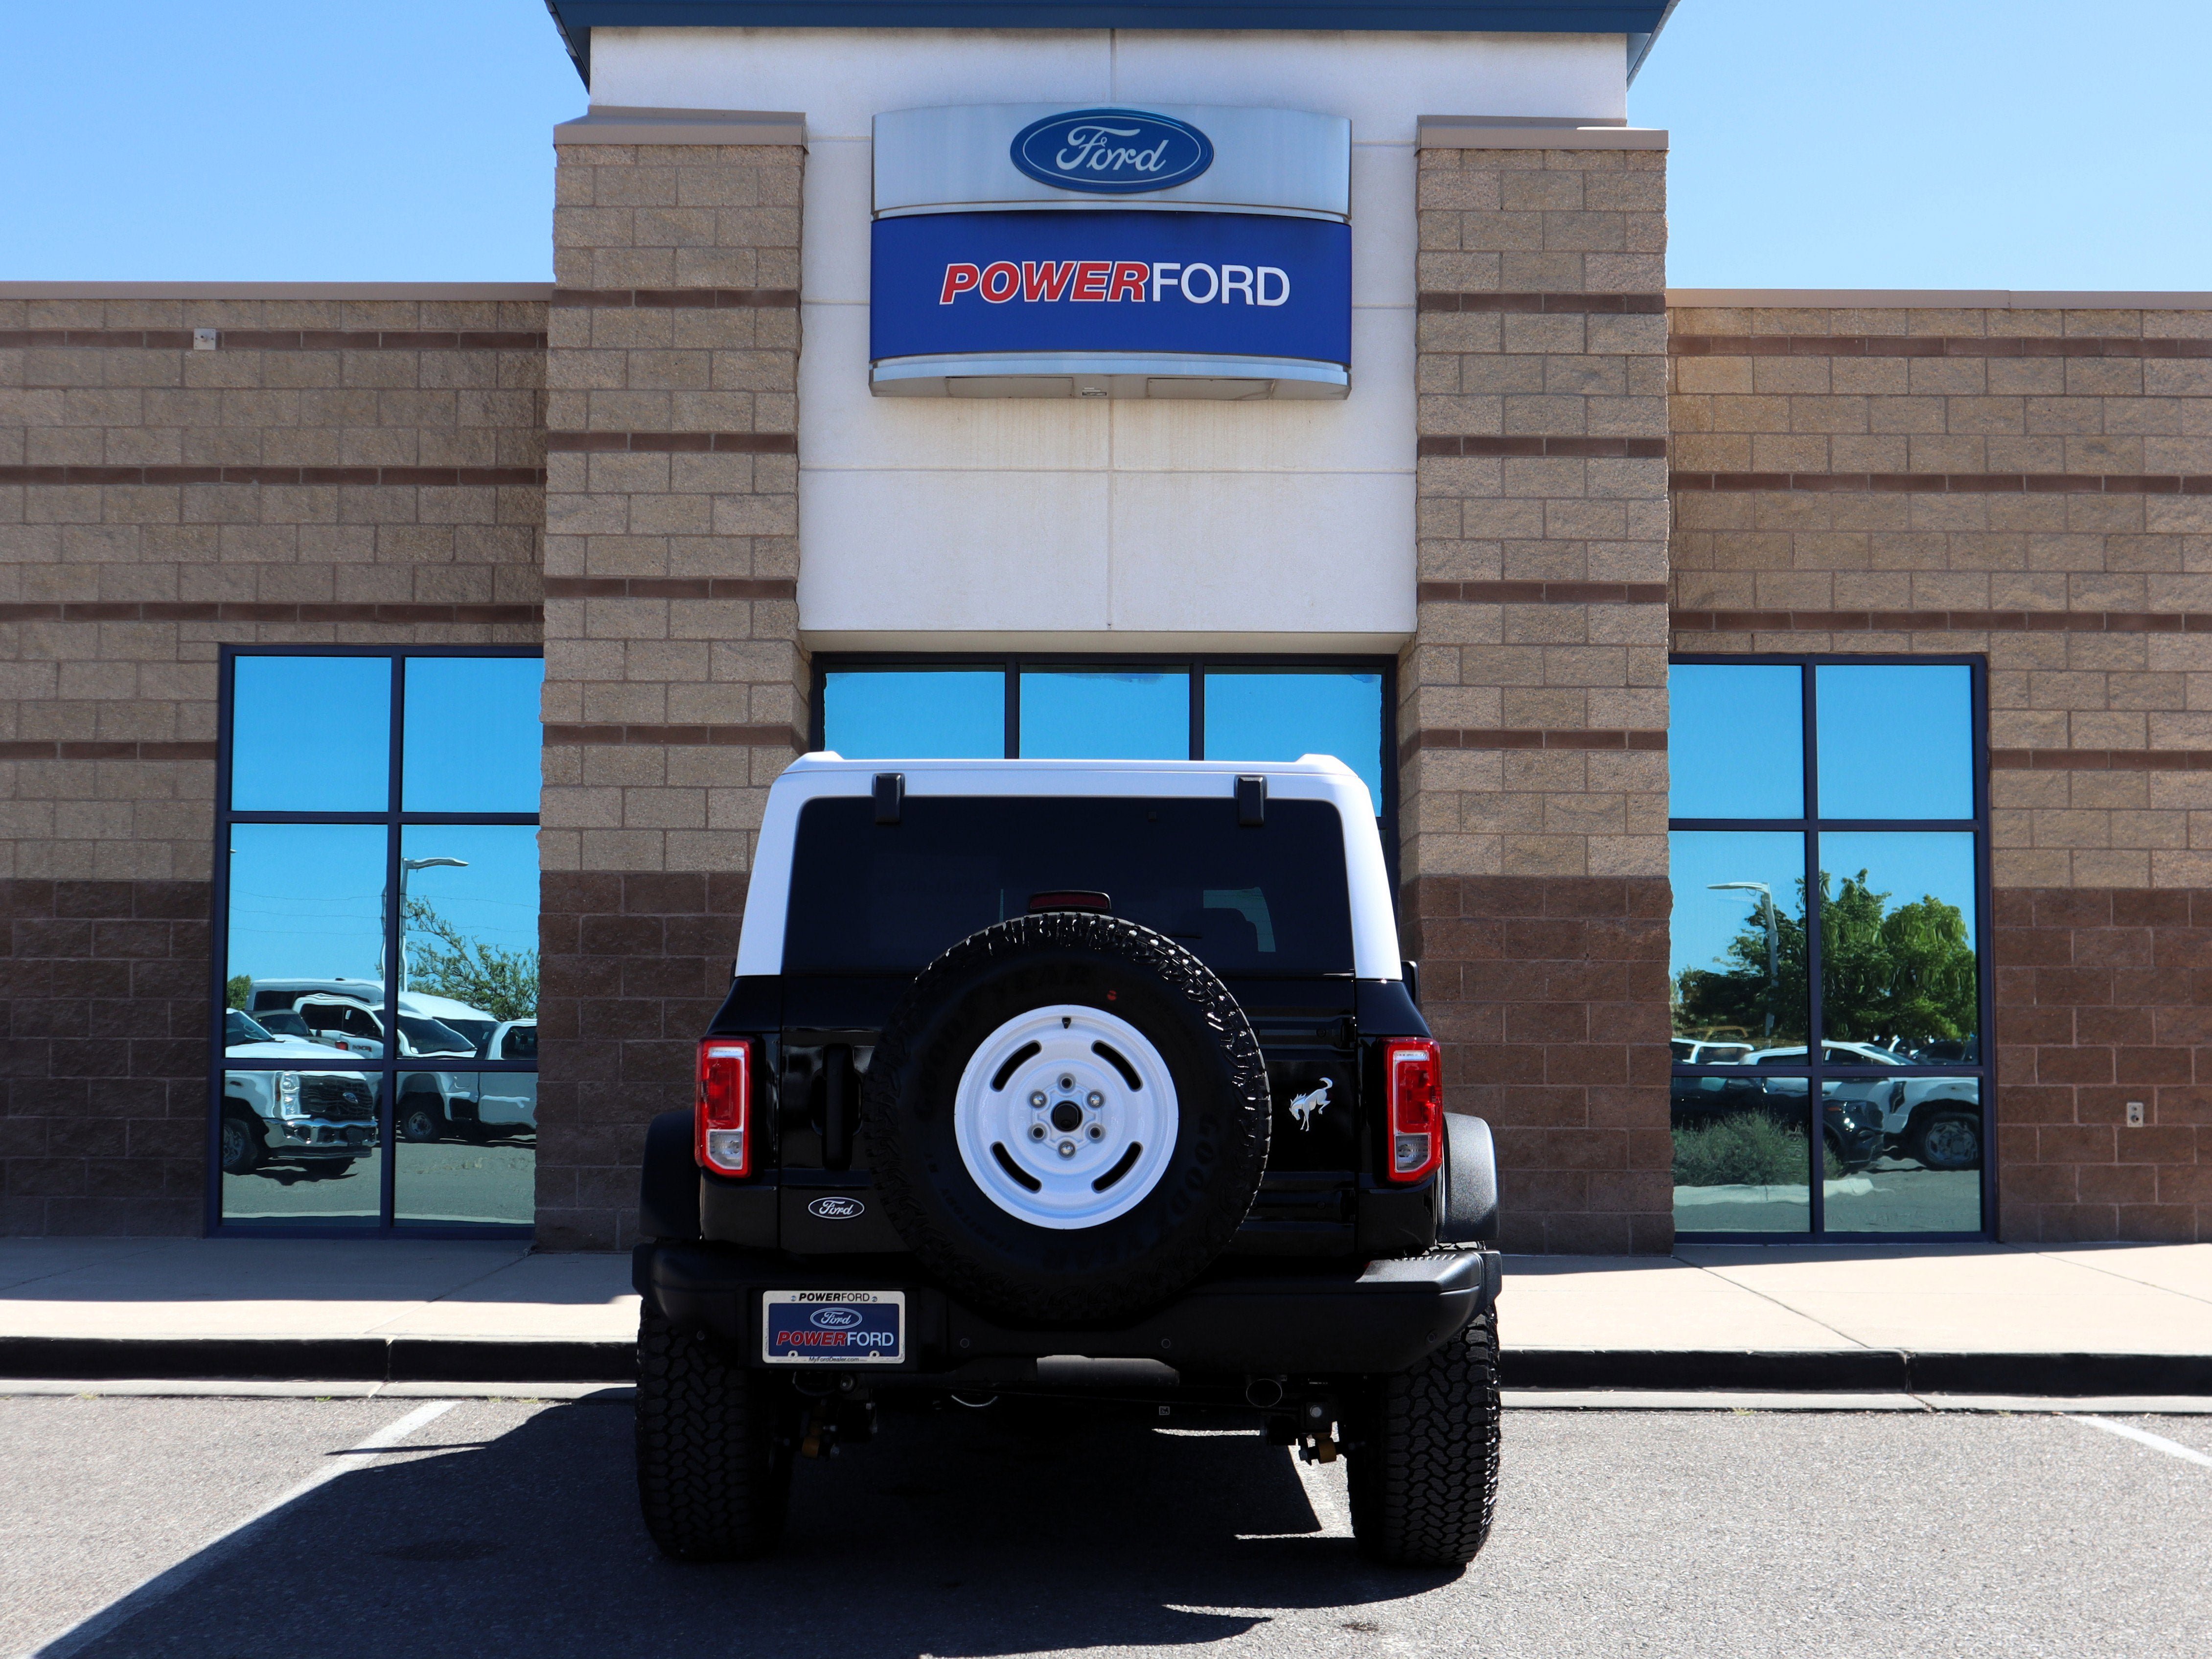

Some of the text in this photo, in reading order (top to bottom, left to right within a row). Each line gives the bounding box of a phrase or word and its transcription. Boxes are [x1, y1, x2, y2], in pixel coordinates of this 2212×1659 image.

[1056, 125, 1169, 171] Ford
[939, 261, 1290, 306] POWERFORD
[819, 1200, 853, 1215] Ford
[799, 1293, 870, 1302] POWERFORD
[821, 1312, 852, 1324] Ford
[776, 1331, 894, 1346] POWERFORD
